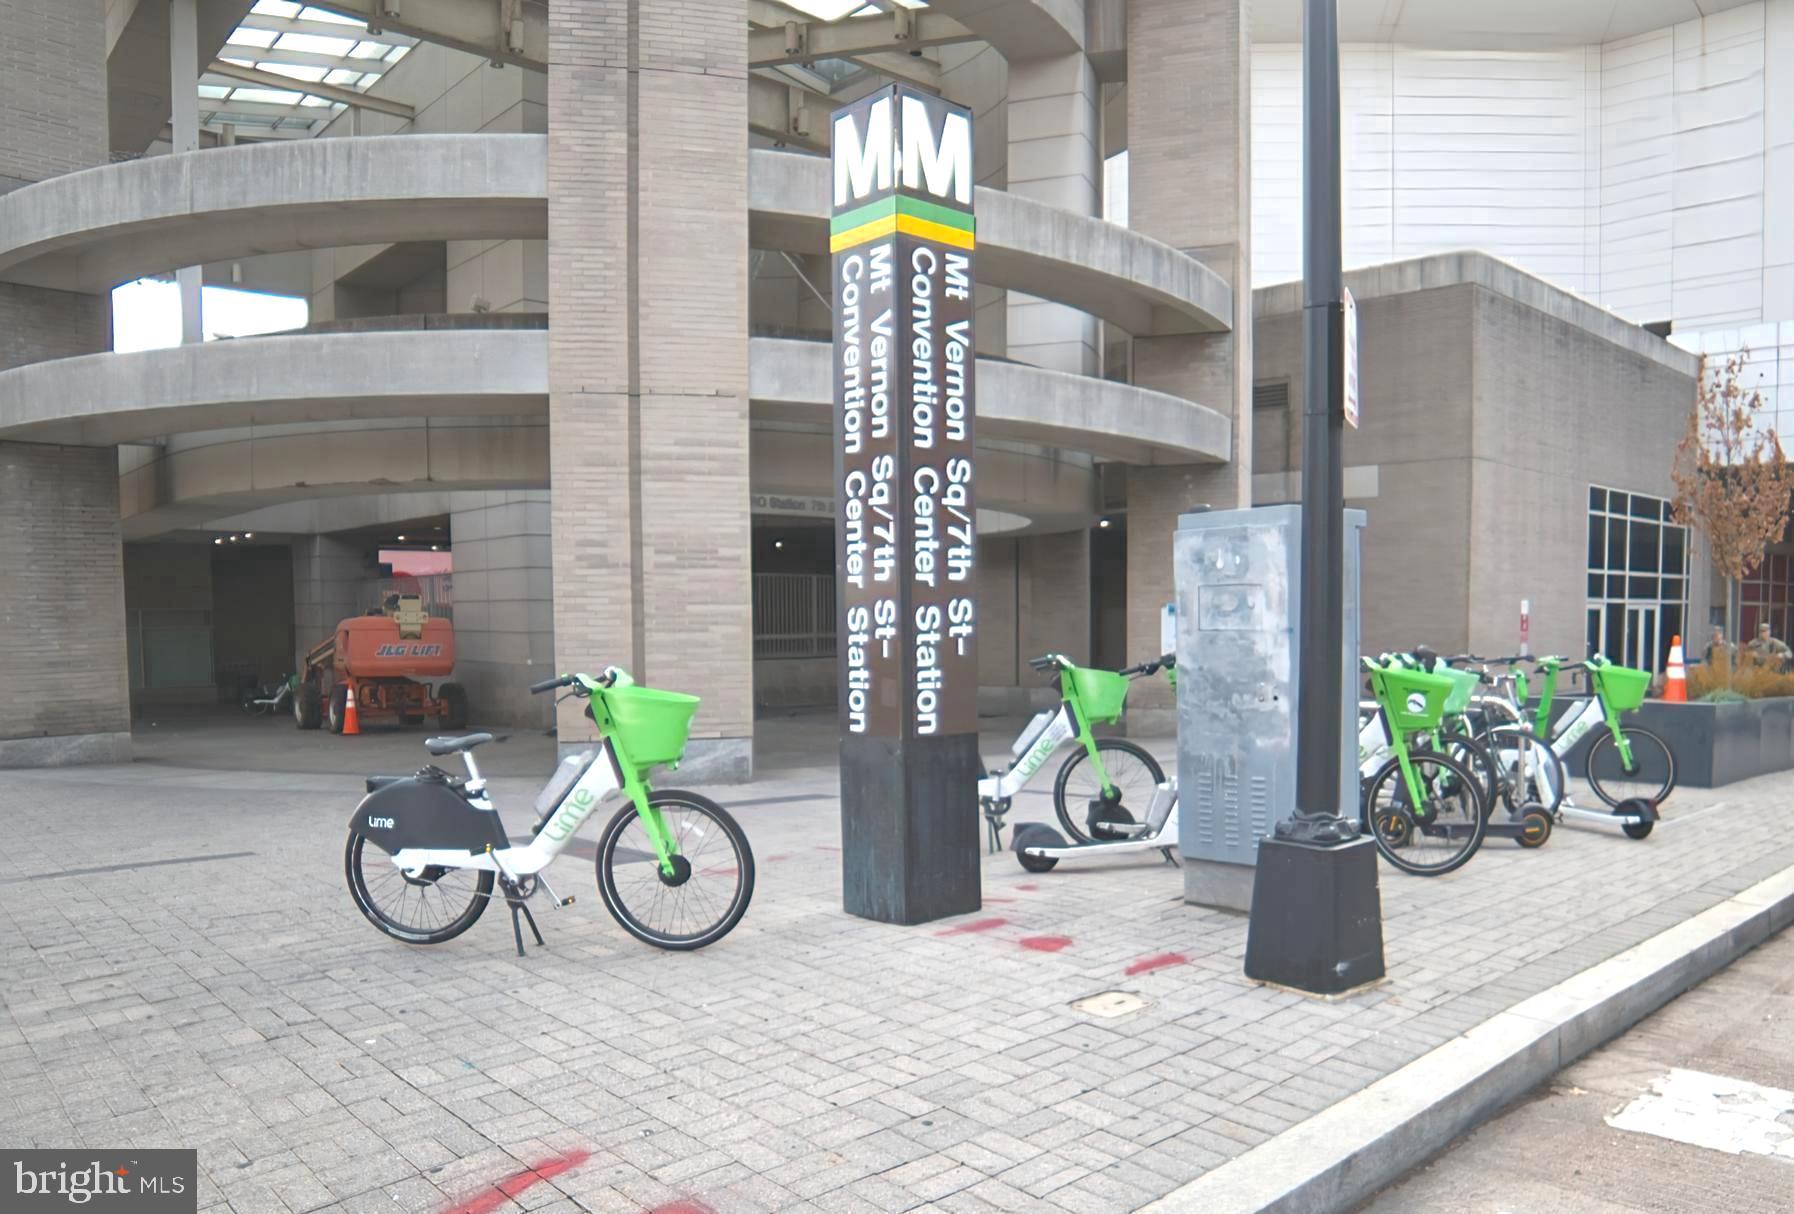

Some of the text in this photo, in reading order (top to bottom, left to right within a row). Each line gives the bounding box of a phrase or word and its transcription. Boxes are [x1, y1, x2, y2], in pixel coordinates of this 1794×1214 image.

[834, 96, 892, 207] M
[902, 95, 970, 206] M
[842, 255, 869, 733] Convention Center Station
[868, 243, 896, 658] Mt Vernon Sq/7th St-
[911, 247, 942, 735] Convention Center Station
[941, 253, 973, 655] Mt Vernon Sq/7th St-
[375, 643, 443, 657] JLG LIFT
[1017, 739, 1054, 776] Lime
[368, 815, 395, 829] Lime
[544, 788, 594, 841] Lime
